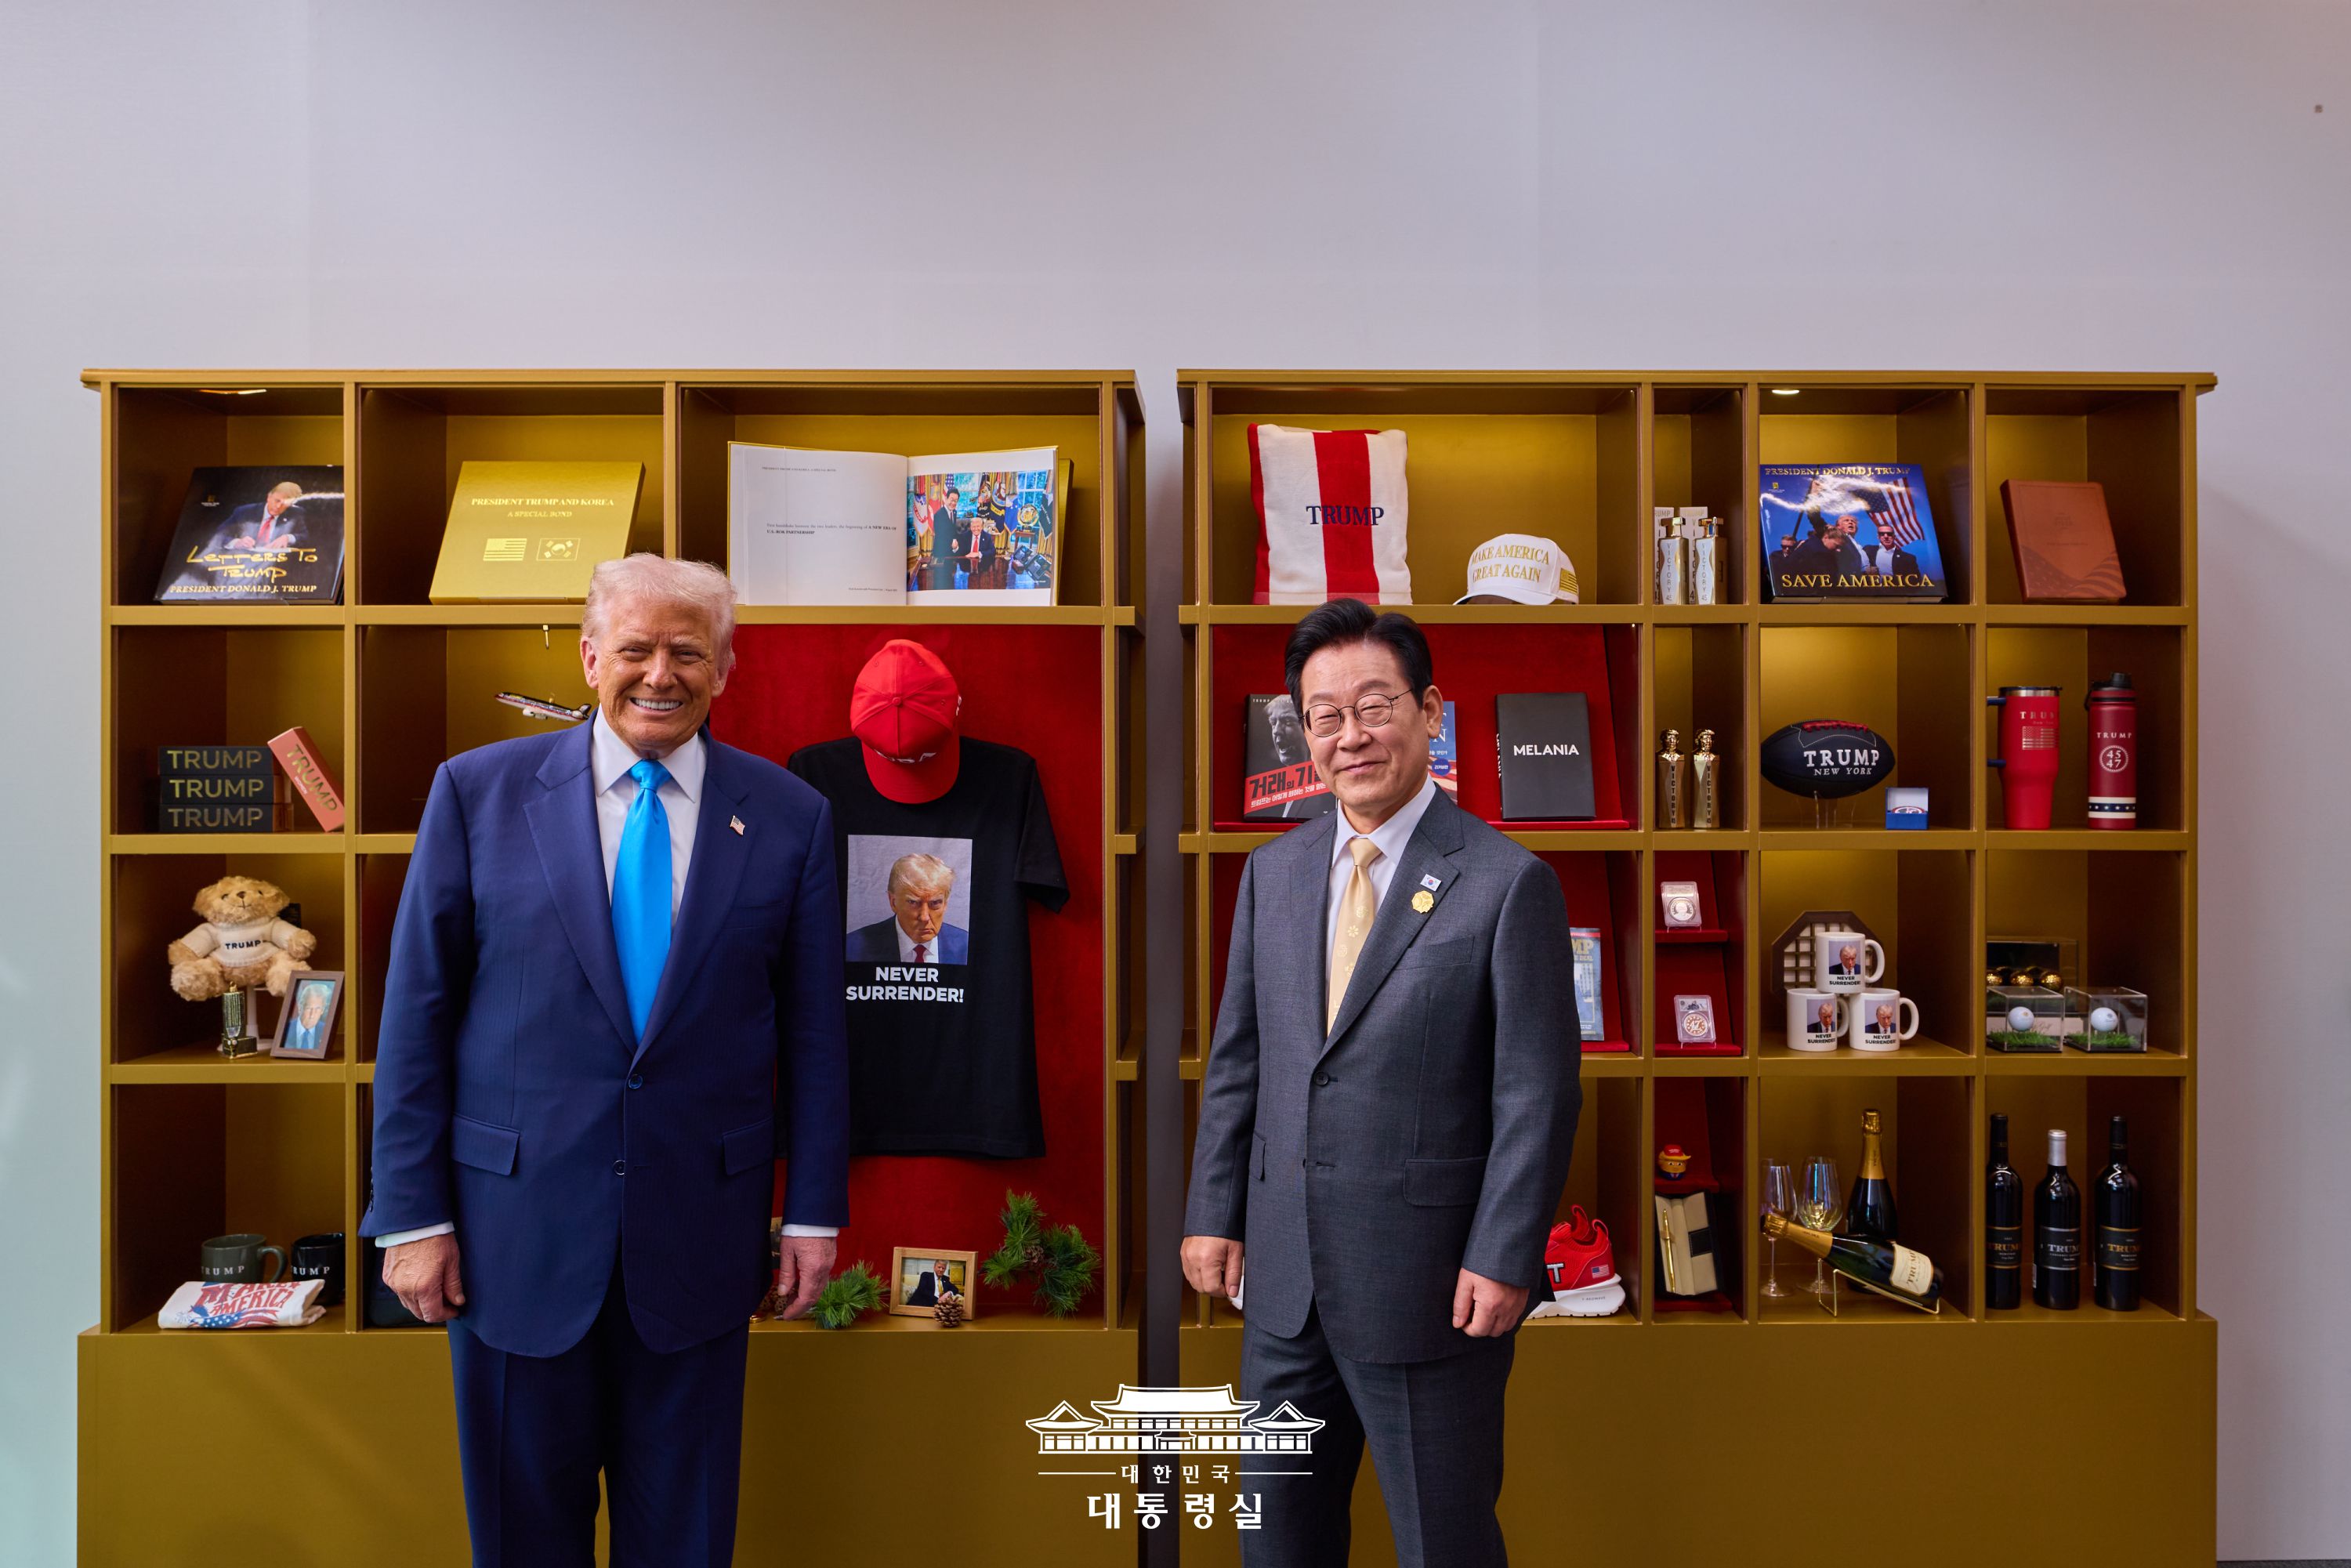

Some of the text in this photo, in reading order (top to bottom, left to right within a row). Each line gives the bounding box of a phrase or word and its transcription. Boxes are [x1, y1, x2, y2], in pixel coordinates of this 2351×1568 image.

[1822, 466, 1866, 476] DONALD
[1867, 467, 1874, 476] J.
[1306, 505, 1385, 526] TRUMP
[1472, 544, 1549, 565] MAKE AMERICA
[1473, 563, 1541, 583] GREAT AGAIN
[1781, 574, 1935, 588] SAVE AMERICA
[270, 585, 278, 594] J.
[1513, 744, 1580, 756] MELANIA
[1803, 748, 1880, 767] TRUMP
[2106, 750, 2121, 759] 45
[166, 750, 263, 770] TRUMP
[2106, 759, 2122, 768] 47
[287, 744, 338, 812] TRUMP
[1249, 770, 1295, 798] 거래의
[168, 779, 264, 798] TRUMP
[1250, 798, 1271, 808] 트럼프는
[1272, 792, 1288, 802] 어떻게
[168, 808, 263, 827] TRUMP
[225, 940, 261, 950] TRUMP
[875, 966, 939, 983] NEVER
[846, 986, 964, 1003] SURRENDER!
[1546, 1262, 1565, 1284] T
[210, 1289, 295, 1315] AMERICA
